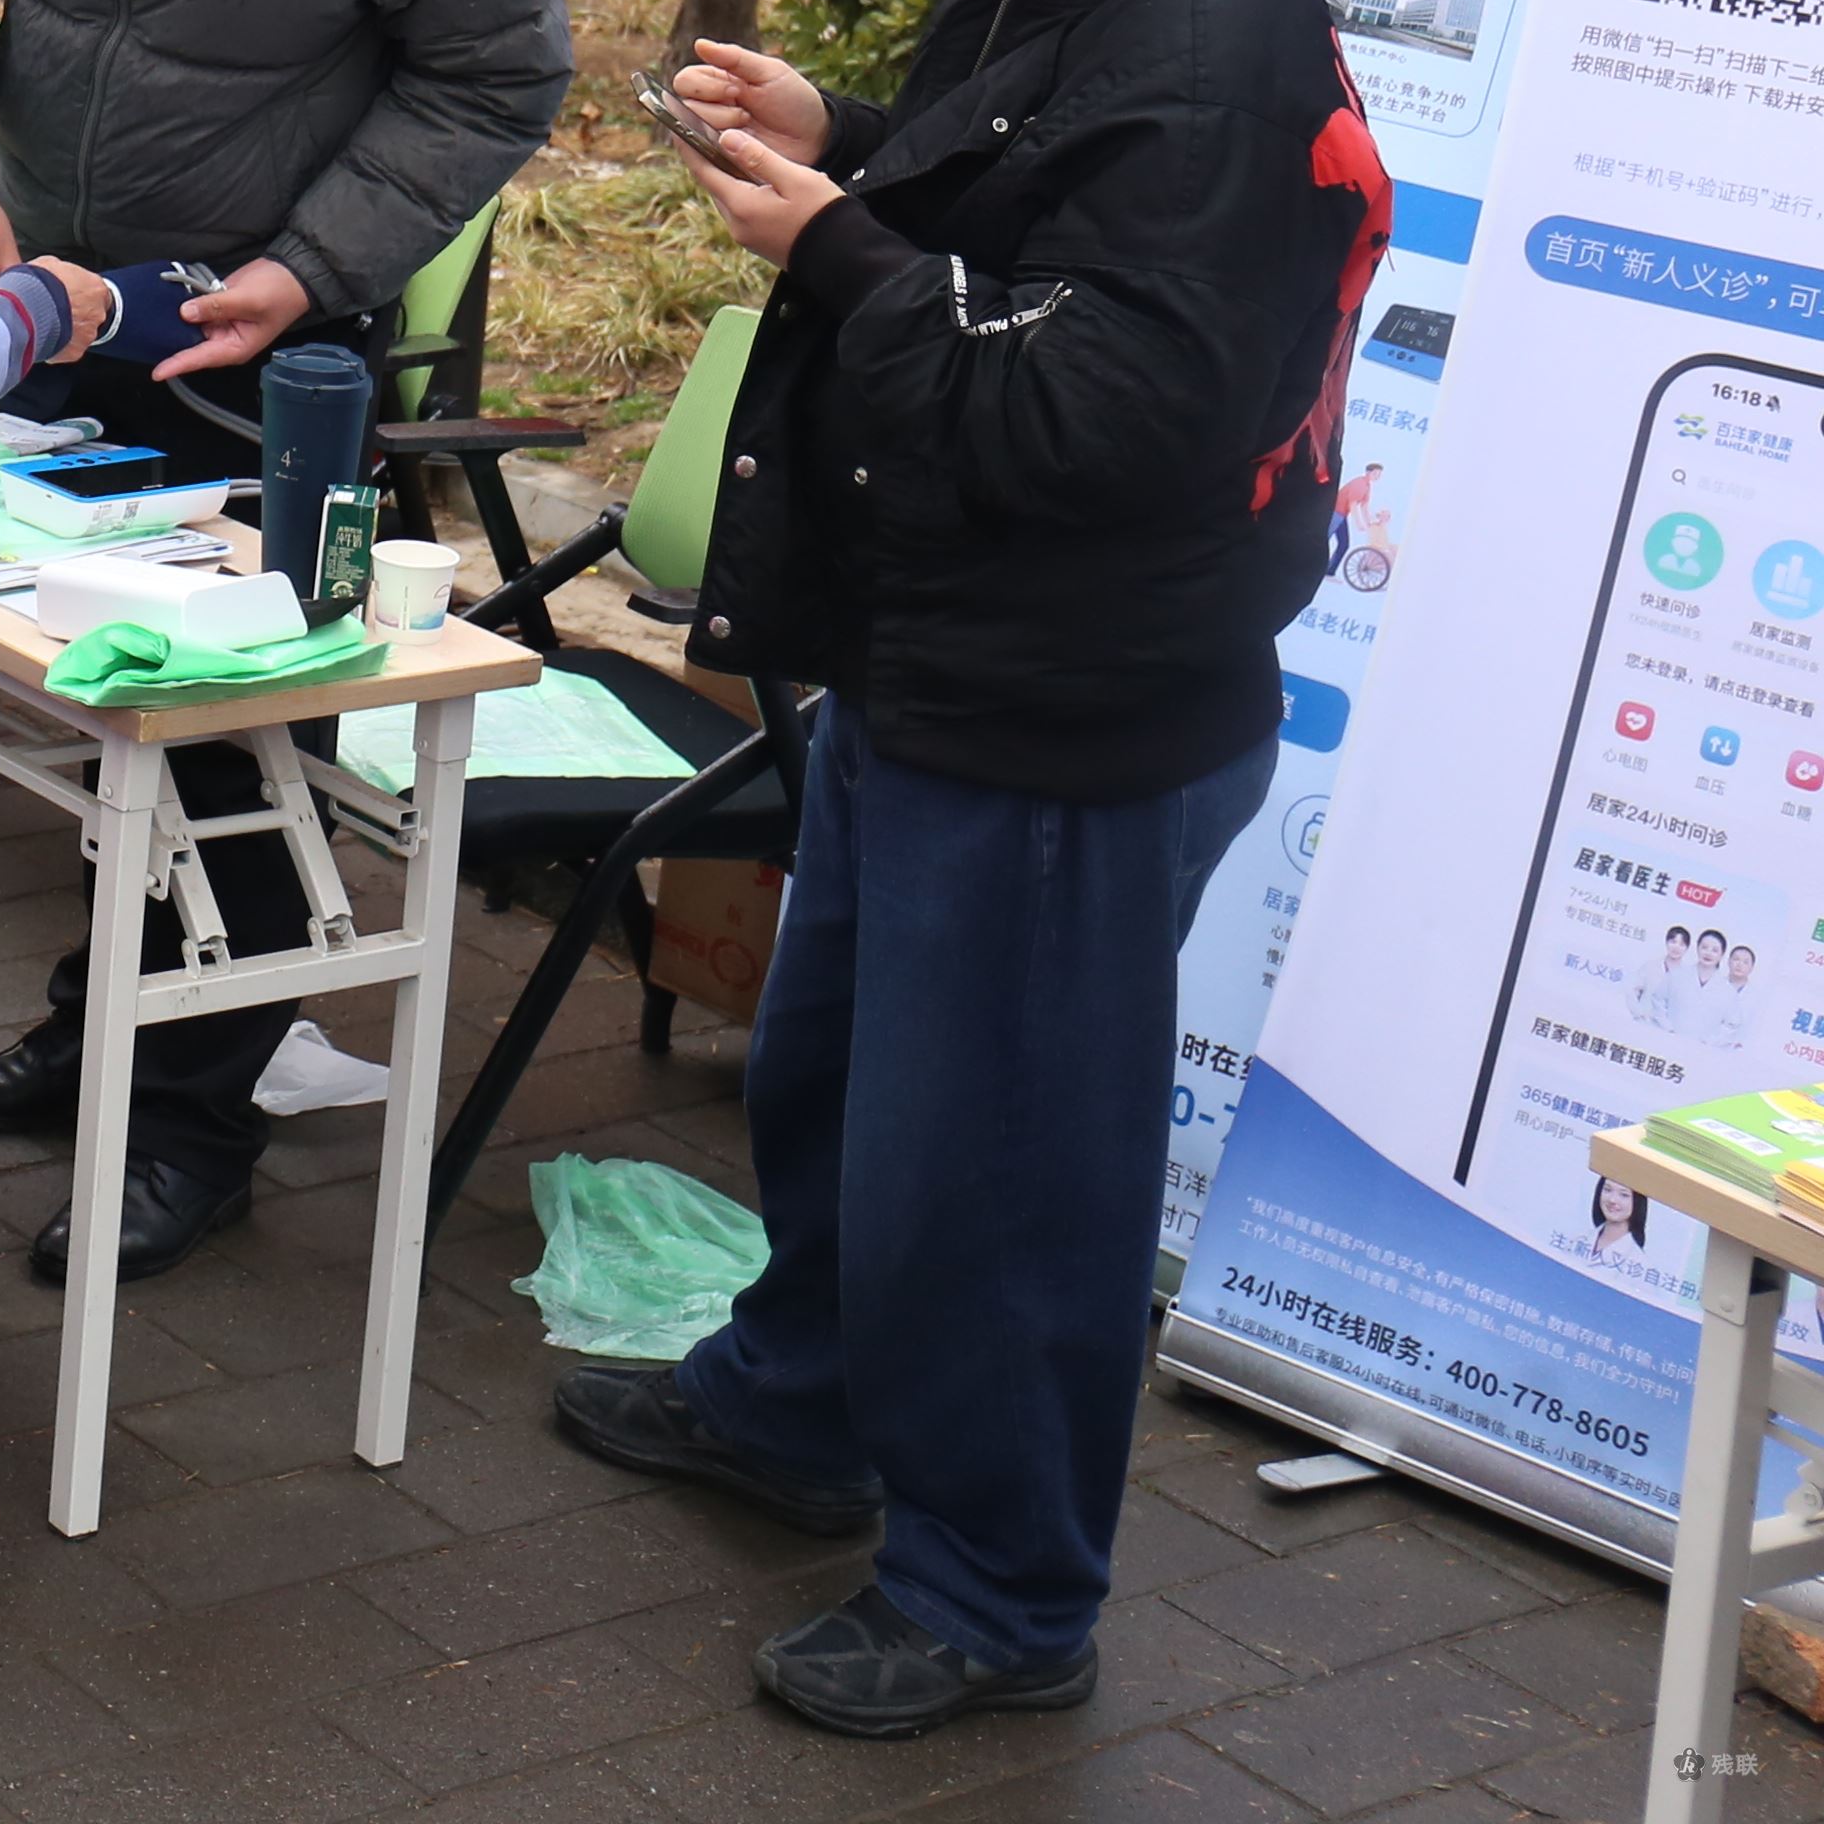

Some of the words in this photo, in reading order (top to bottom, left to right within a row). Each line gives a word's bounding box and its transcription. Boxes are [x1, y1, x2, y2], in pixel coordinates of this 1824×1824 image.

[1570, 52, 1738, 100] 按照图中提示操作
[1544, 232, 1824, 319] 首页“新人义诊”，可
[1711, 382, 1763, 407] 16:18
[1714, 437, 1755, 455] BAHEAL
[1758, 448, 1790, 463] HOME
[1716, 421, 1793, 452] 百洋家健康
[1640, 592, 1701, 619] 快速问诊
[1749, 622, 1813, 651] 居家监测
[1602, 748, 1649, 773] 心电图
[1694, 776, 1727, 796] 血压
[1586, 792, 1729, 848] 居家24小时问诊
[1573, 847, 1672, 896] 居家看医生
[1682, 884, 1712, 905] HOT
[1266, 948, 1283, 967] 慢
[1564, 952, 1623, 983] 新人义诊
[1531, 1016, 1685, 1084] 居家健康管理服务
